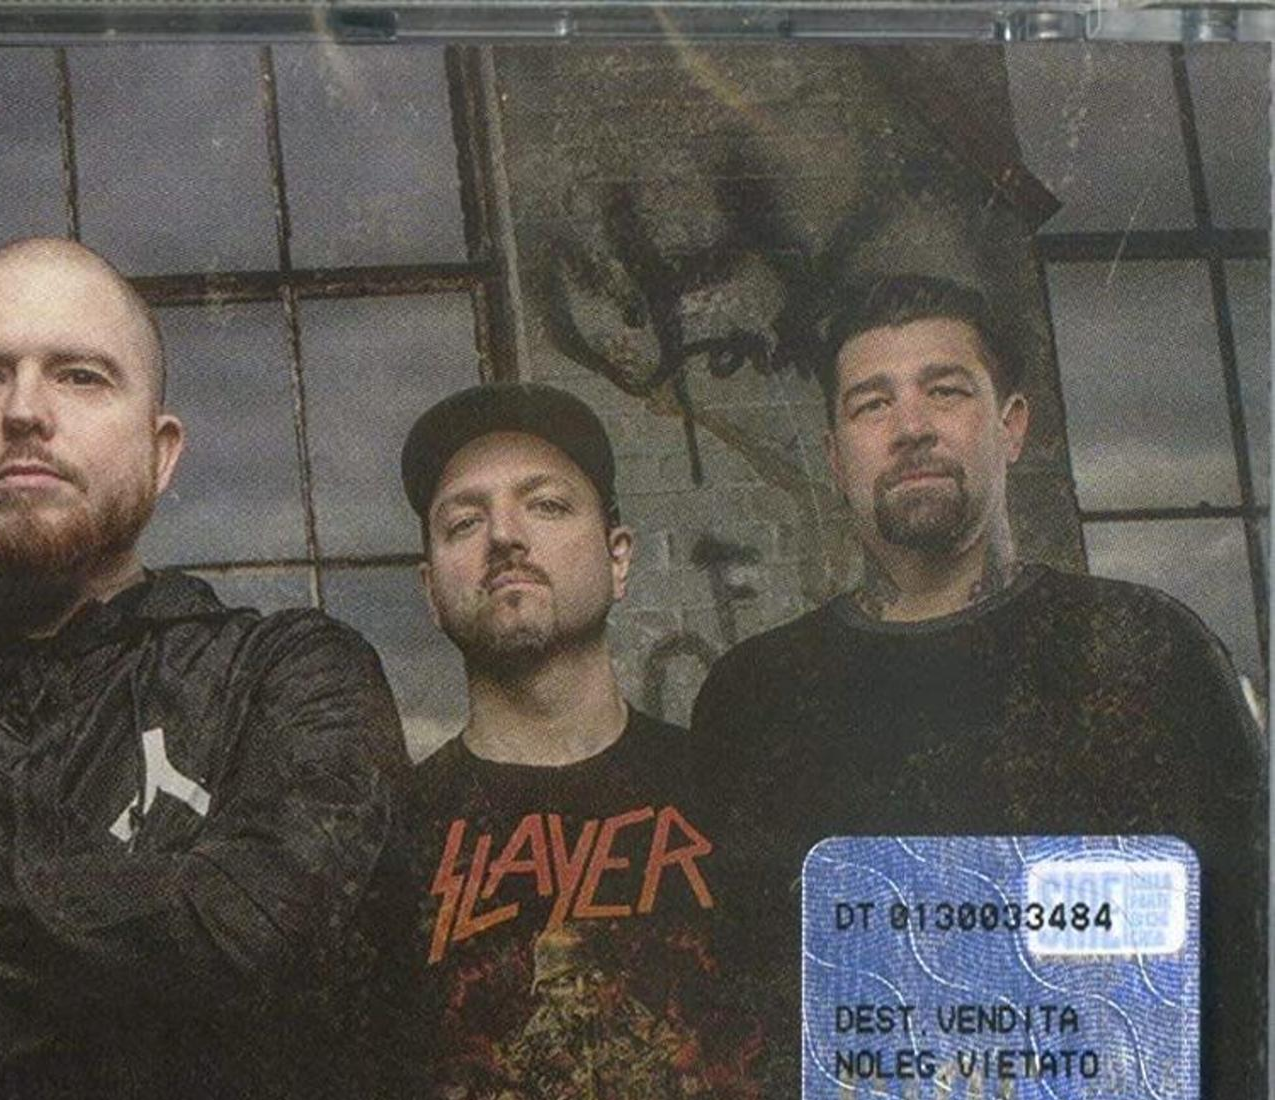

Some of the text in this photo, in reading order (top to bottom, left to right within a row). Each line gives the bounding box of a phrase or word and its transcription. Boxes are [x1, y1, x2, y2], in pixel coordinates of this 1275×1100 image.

[428, 805, 715, 965] SLAYER
[835, 902, 1113, 932] DT 0130033484
[937, 1005, 1080, 1034] VENDITA
[957, 1050, 1099, 1080] VIETATO
